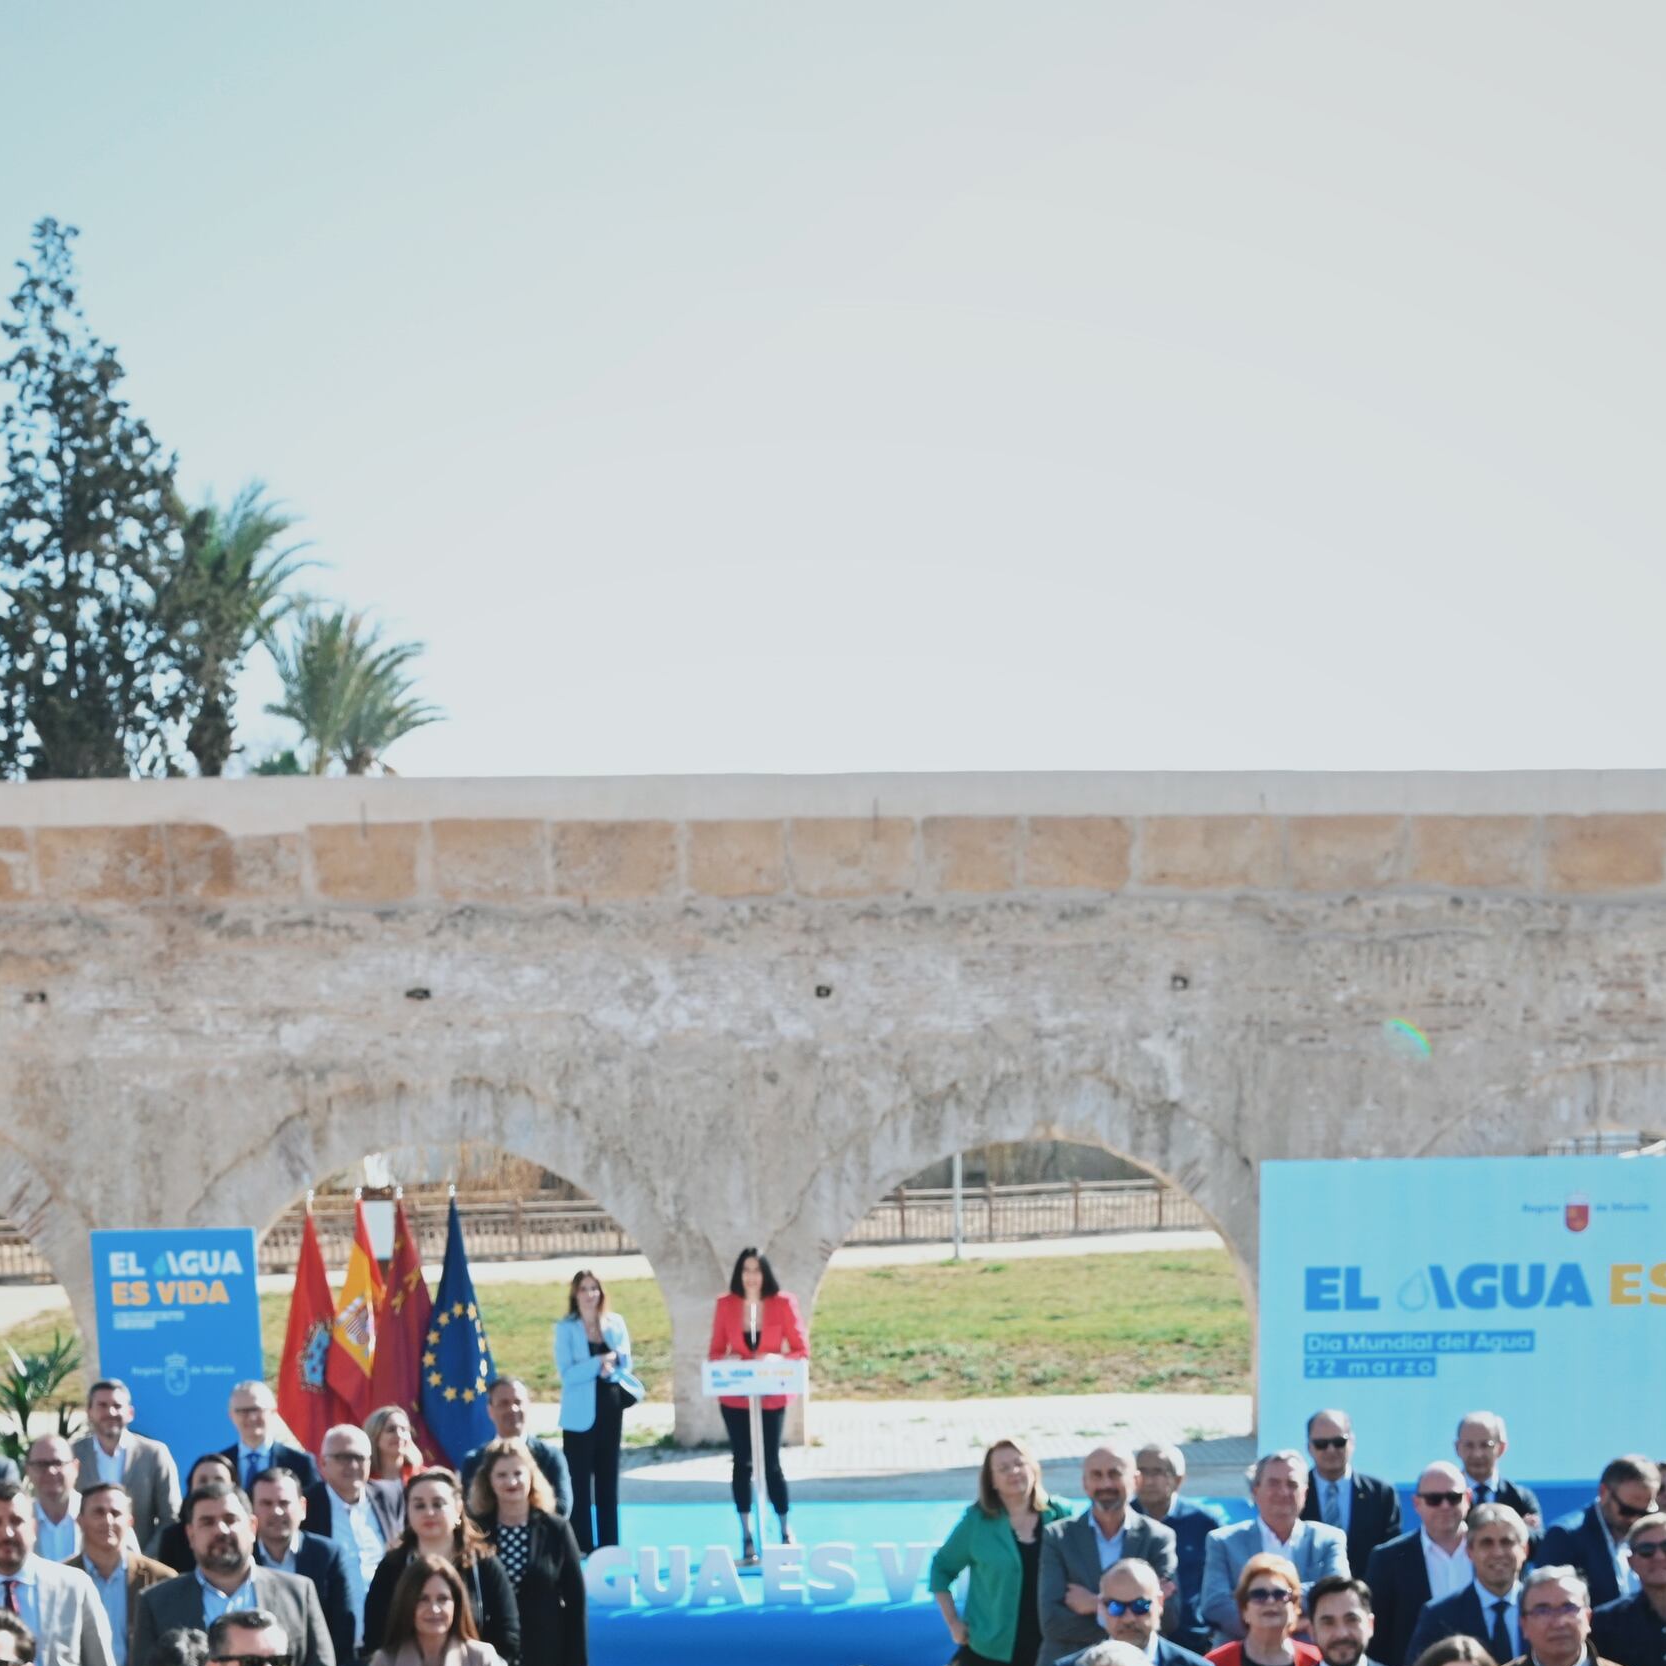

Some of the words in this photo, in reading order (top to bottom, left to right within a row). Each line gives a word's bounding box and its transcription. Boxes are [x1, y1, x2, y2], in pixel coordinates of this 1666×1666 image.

[109, 1251, 147, 1277] EL
[112, 1281, 150, 1306] ES
[156, 1280, 230, 1305] VIDA
[1304, 1266, 1380, 1312] EL
[1346, 1333, 1433, 1352] Mundial
[1436, 1333, 1470, 1351] del
[1474, 1332, 1531, 1354] Agua
[1348, 1360, 1434, 1377] marzo
[585, 1545, 749, 1607] GUA
[763, 1542, 859, 1606] ES
